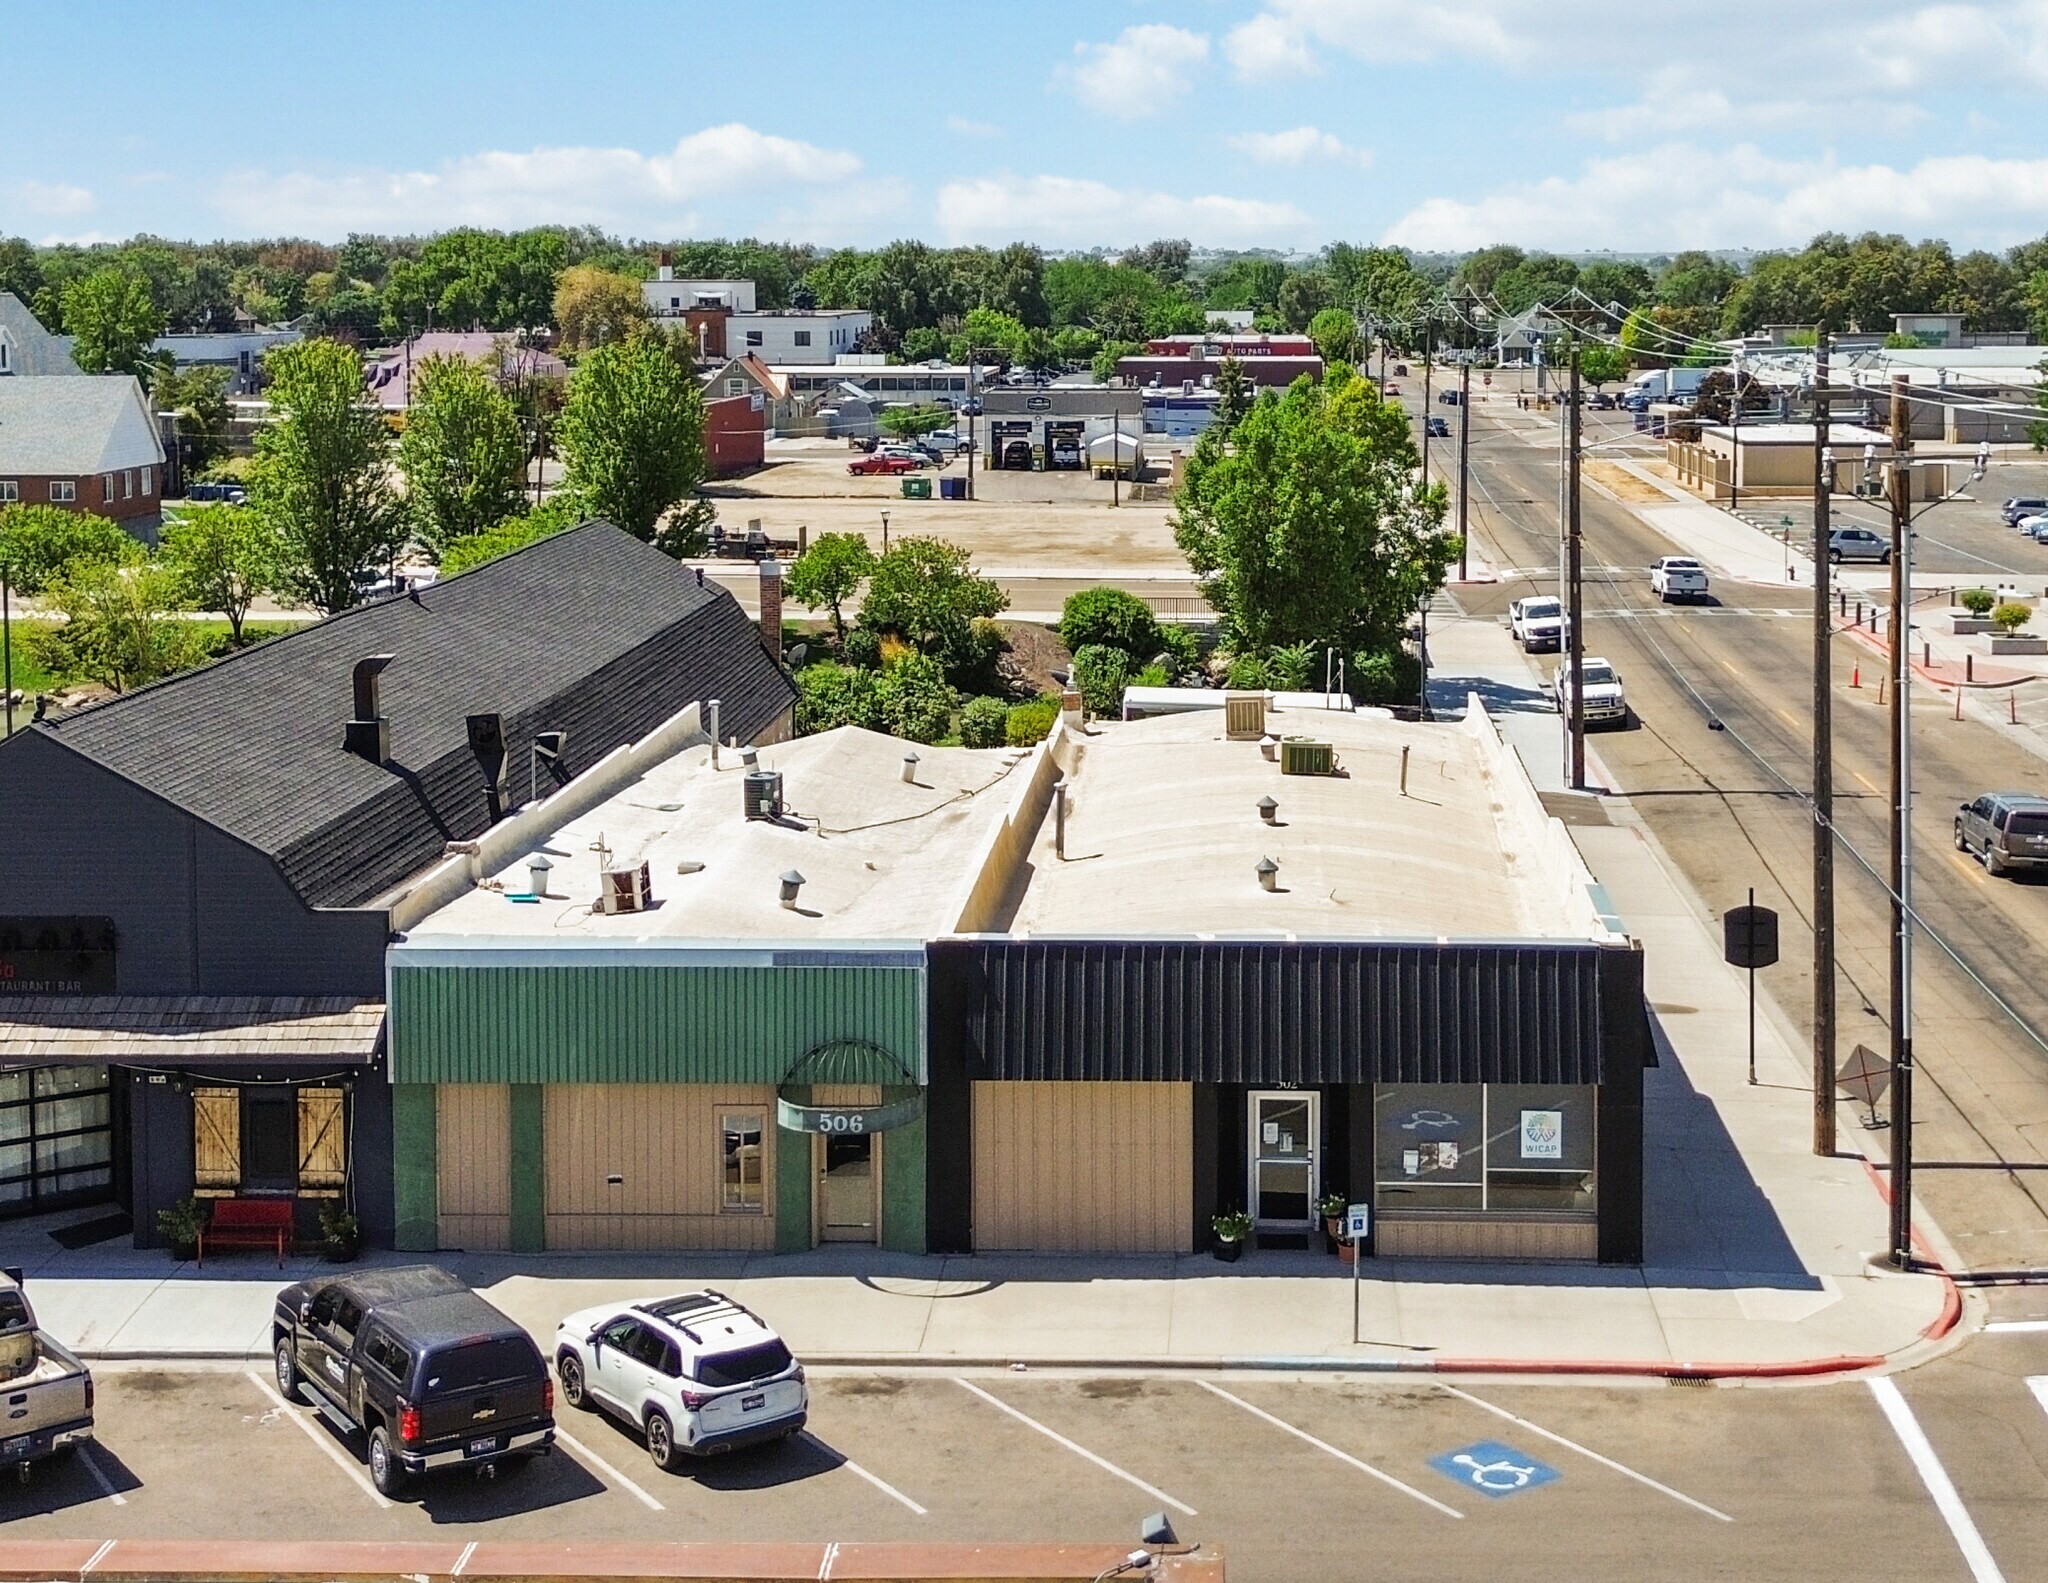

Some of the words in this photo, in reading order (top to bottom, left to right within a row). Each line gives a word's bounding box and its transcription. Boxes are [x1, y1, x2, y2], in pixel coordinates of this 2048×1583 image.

[1227, 347, 1246, 355] AUTO
[1247, 347, 1271, 356] PARTS
[57, 980, 82, 992] BAR
[820, 1113, 864, 1133] 506
[1525, 1144, 1557, 1153] WICAP
